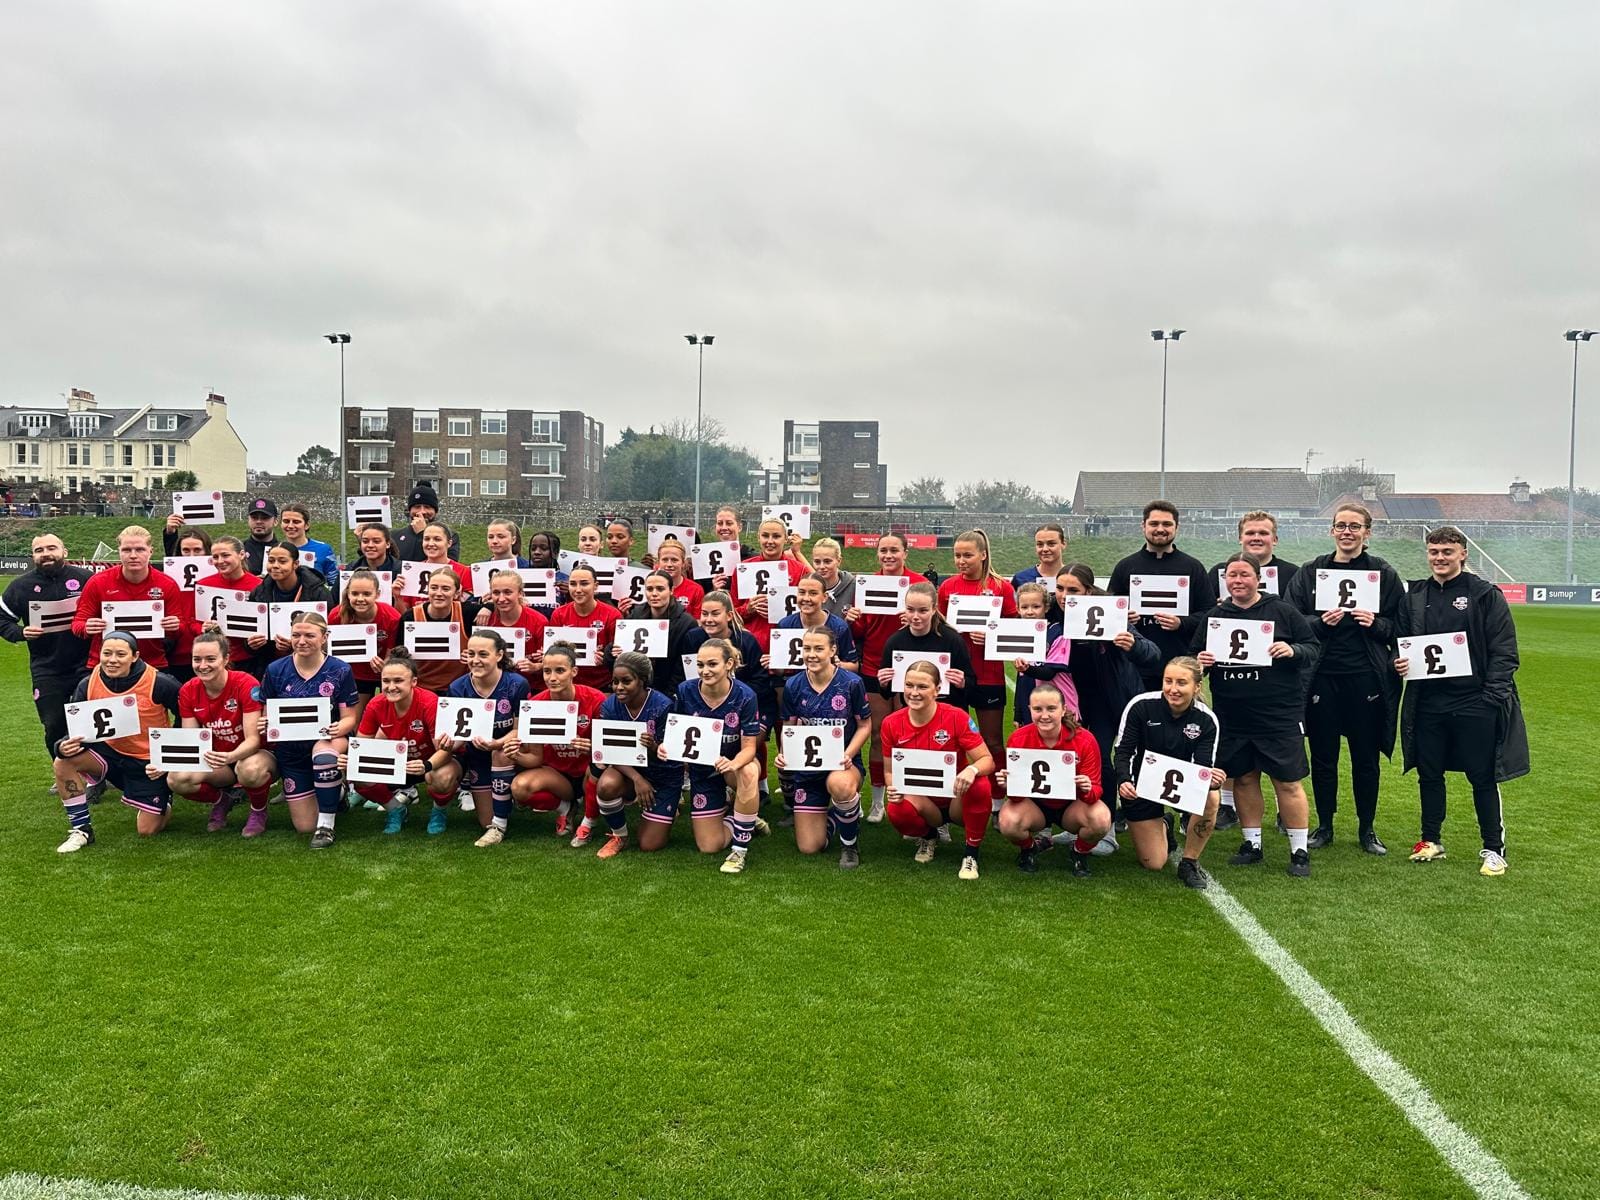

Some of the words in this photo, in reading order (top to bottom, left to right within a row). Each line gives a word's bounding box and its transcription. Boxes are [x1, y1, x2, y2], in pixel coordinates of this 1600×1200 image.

[0, 561, 19, 569] Level
[19, 562, 28, 571] up
[709, 551, 725, 576] £
[628, 576, 646, 603] £
[756, 570, 771, 595] £
[1339, 579, 1356, 608] £
[1548, 590, 1574, 600] sumup
[1086, 607, 1104, 636] £
[633, 628, 648, 656] £
[1228, 629, 1249, 661] £
[1423, 644, 1447, 676] £
[93, 709, 118, 741] £
[206, 717, 232, 729] who
[454, 708, 472, 737] £
[682, 727, 700, 759] £
[805, 736, 822, 767] £
[1031, 761, 1051, 794] £
[1159, 769, 1185, 805] £
